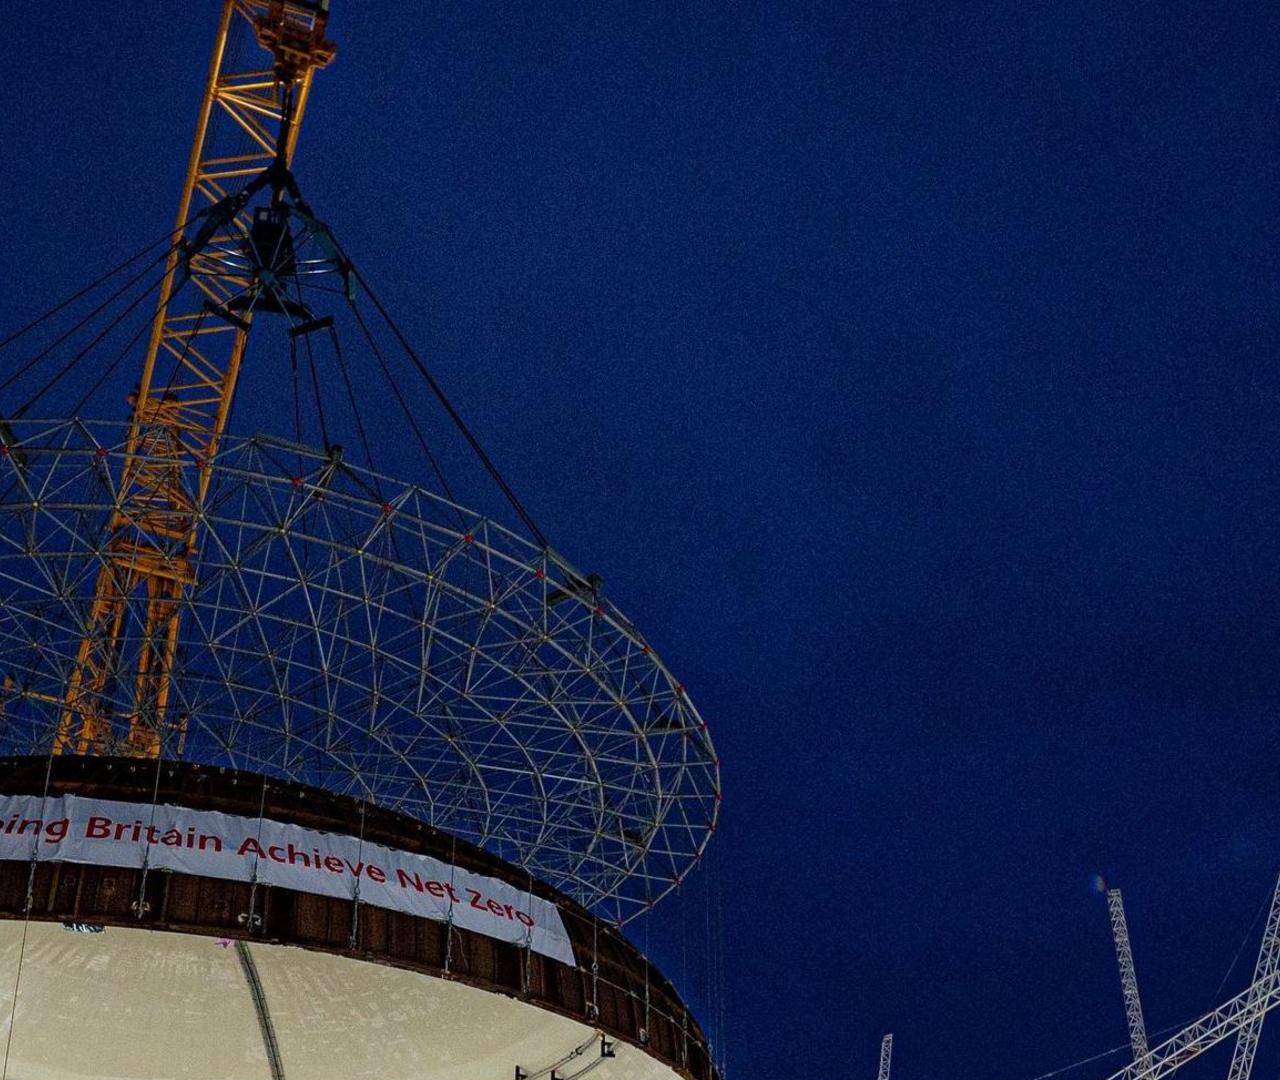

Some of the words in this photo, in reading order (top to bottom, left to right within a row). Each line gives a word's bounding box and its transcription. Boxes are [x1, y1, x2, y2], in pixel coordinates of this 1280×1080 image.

[85, 815, 223, 853] Britain
[236, 836, 387, 884] Achieve
[395, 867, 461, 905] Net
[464, 887, 536, 928] Zero
